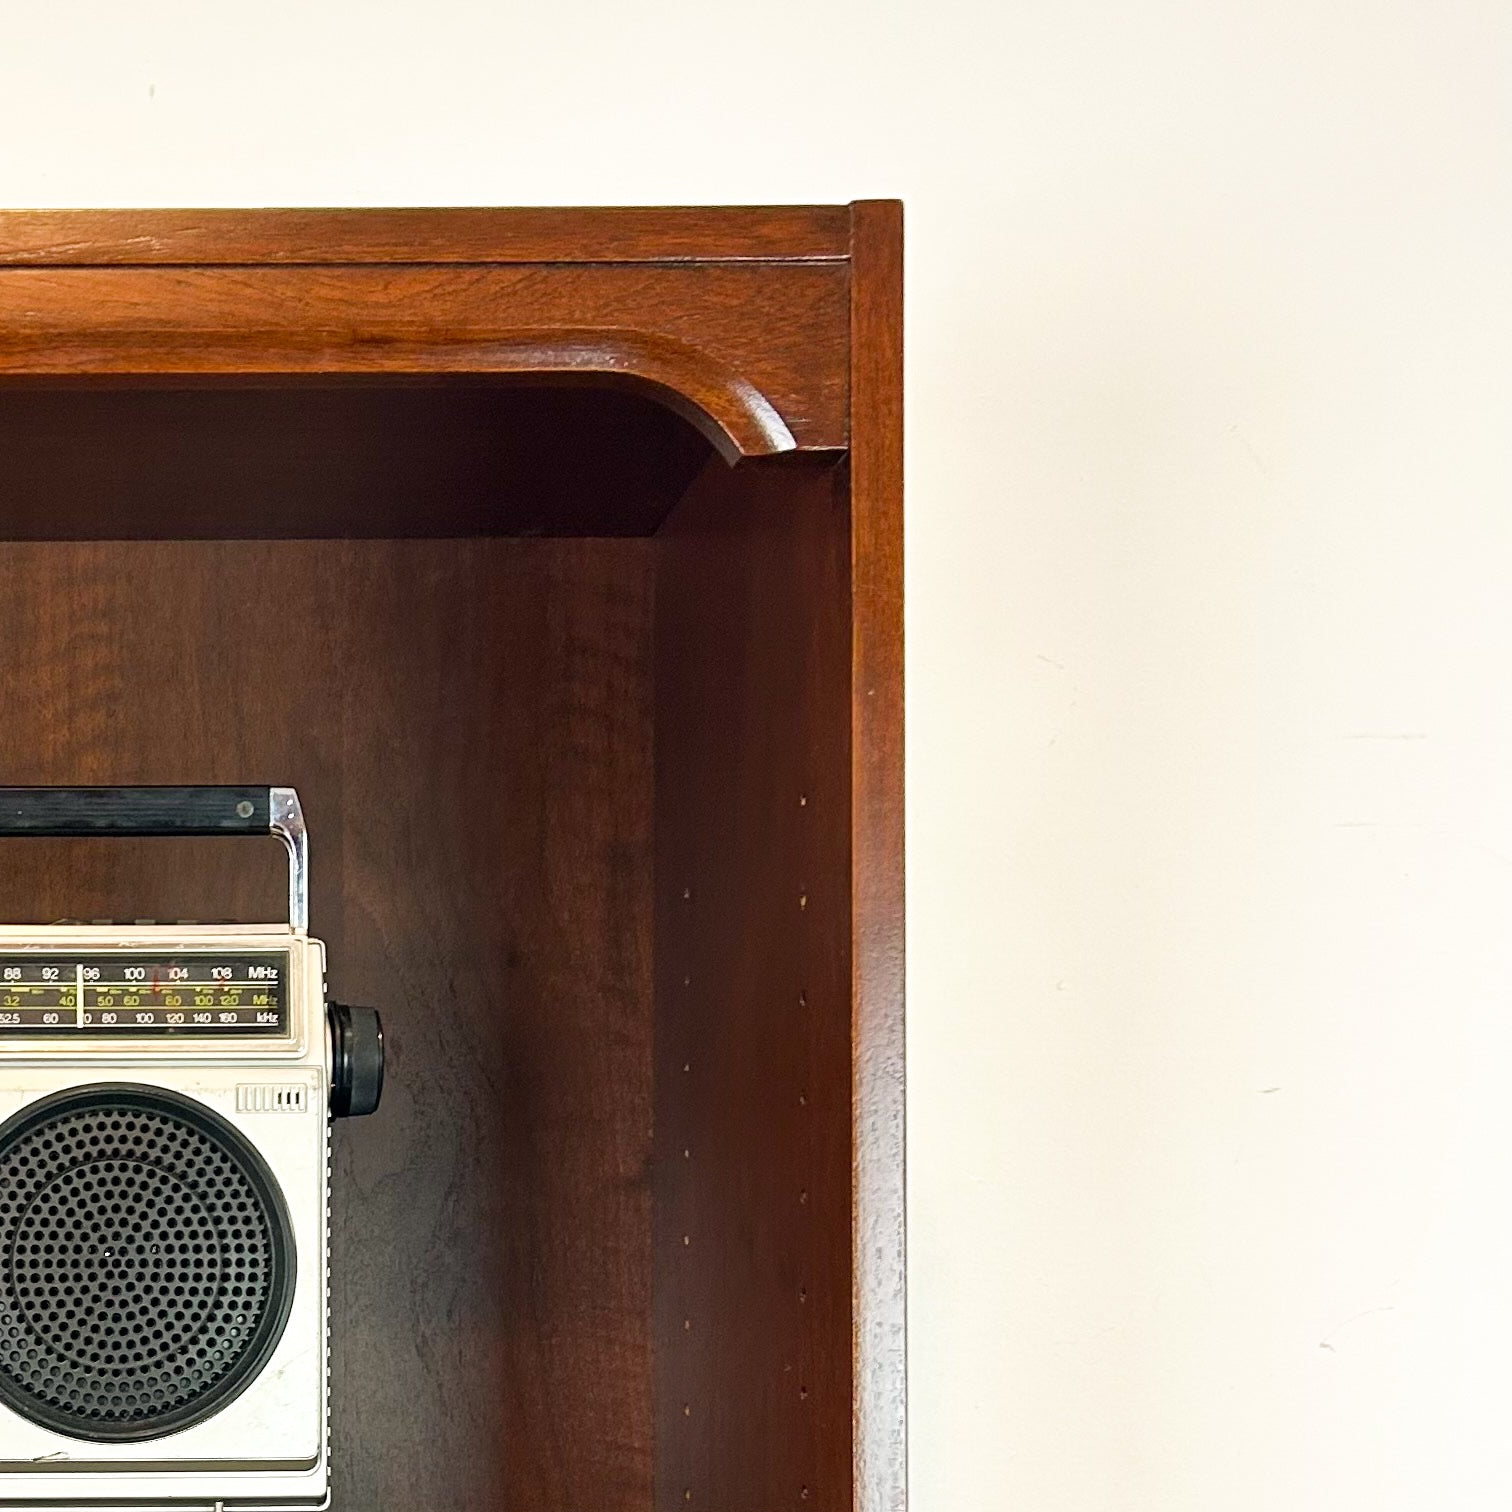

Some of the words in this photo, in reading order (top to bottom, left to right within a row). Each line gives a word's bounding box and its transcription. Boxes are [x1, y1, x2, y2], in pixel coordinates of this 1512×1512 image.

[3, 967, 22, 980] 88
[41, 967, 60, 980] 92
[83, 967, 101, 980] 96
[123, 967, 146, 980] 100
[167, 967, 189, 980] 104
[210, 966, 233, 980] 108
[248, 966, 279, 980] MHz
[42, 1012, 60, 1024] 60
[101, 1012, 118, 1024] 80
[135, 1012, 155, 1024] 100
[165, 1012, 185, 1024] 120
[192, 1012, 212, 1024] 140
